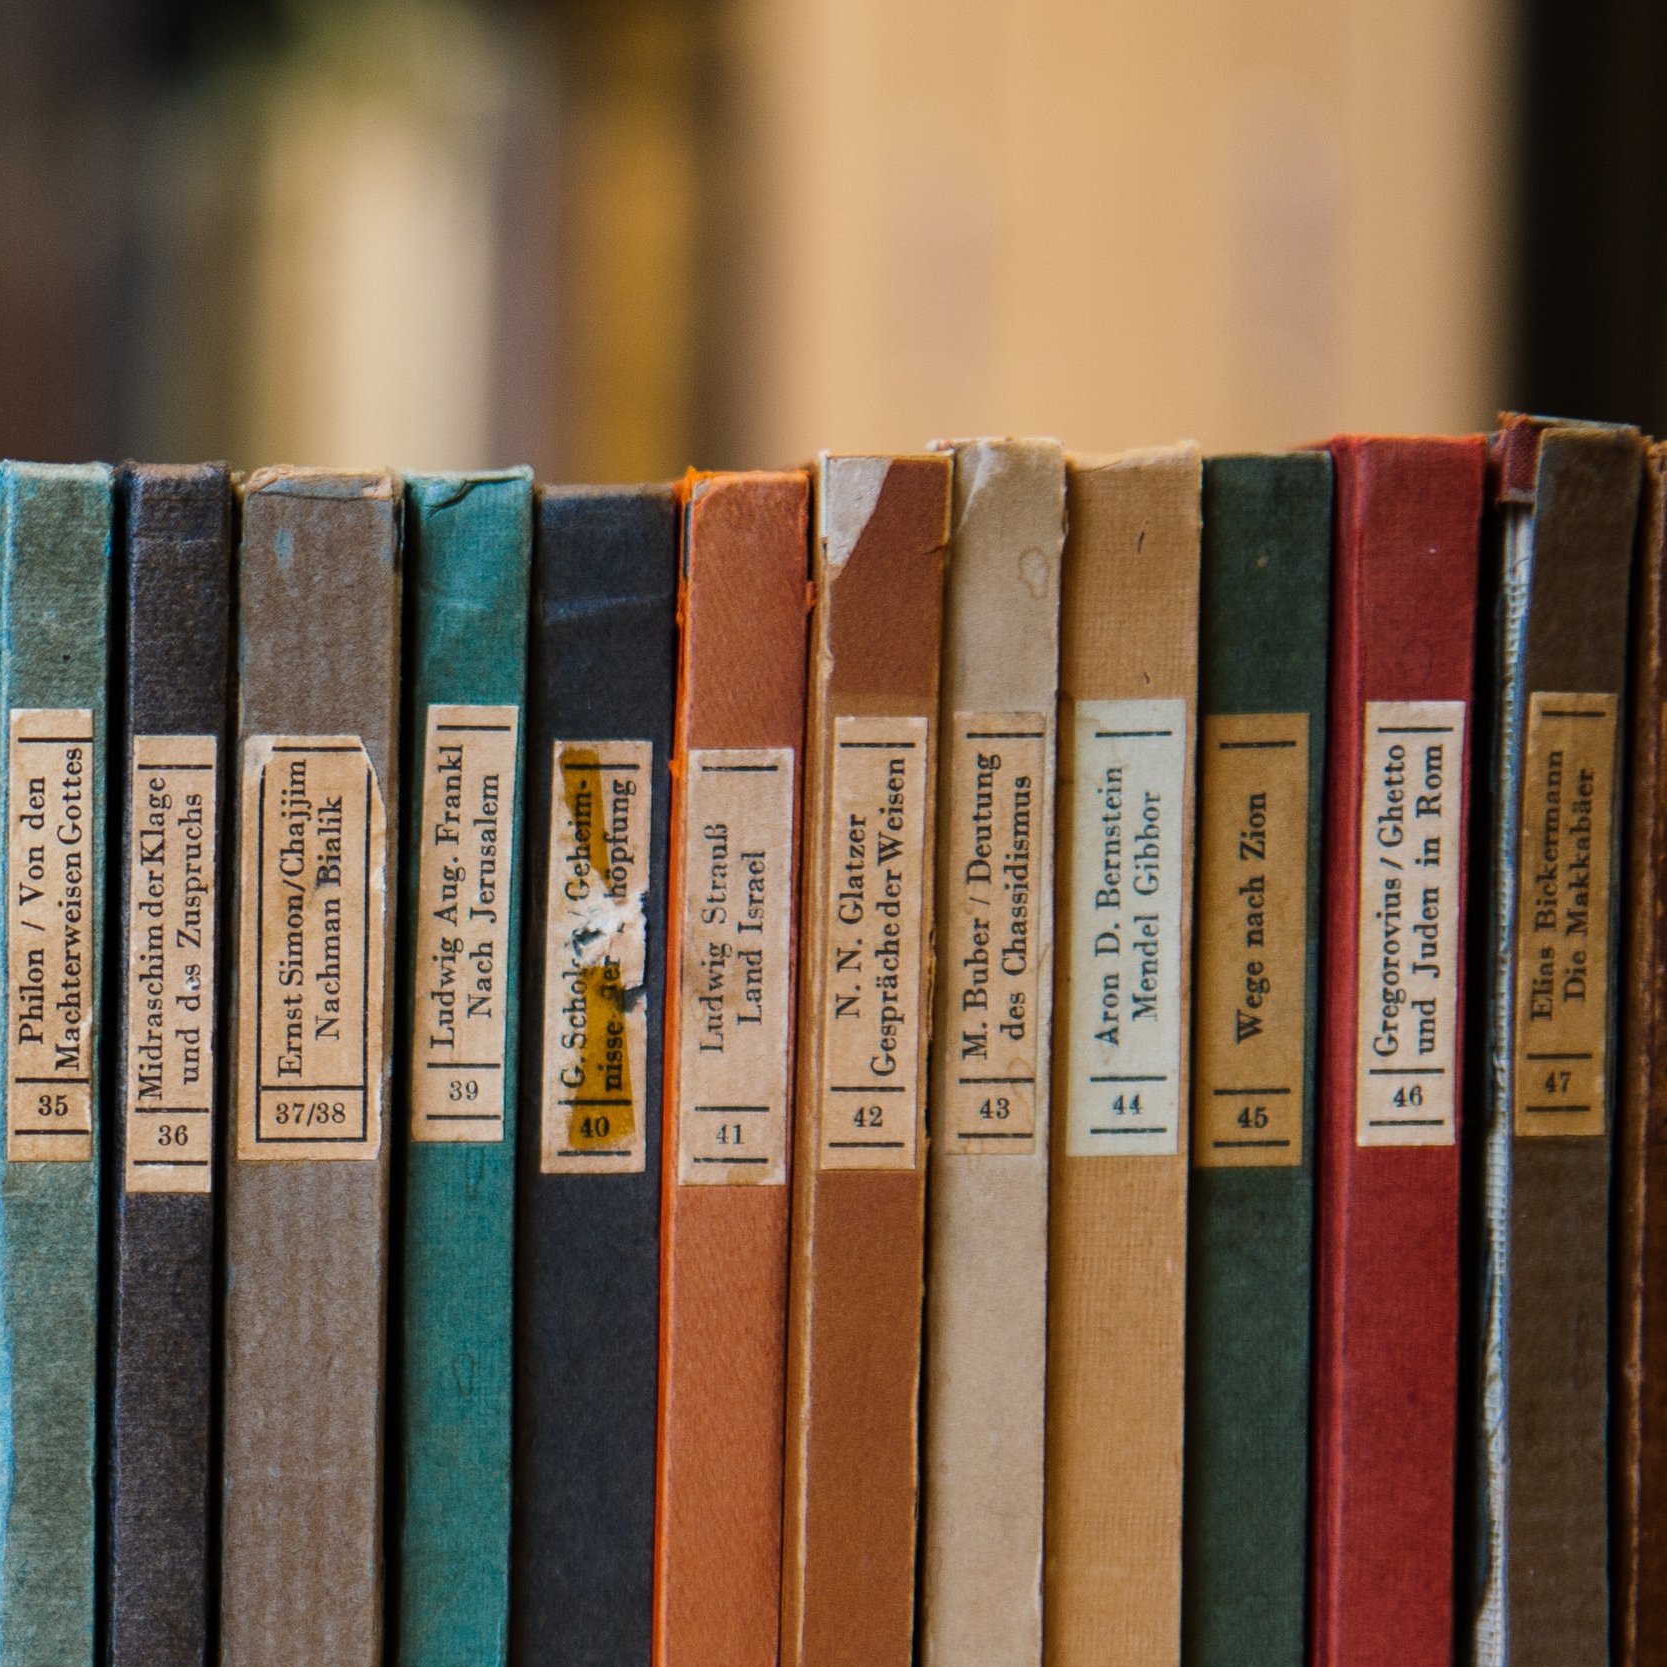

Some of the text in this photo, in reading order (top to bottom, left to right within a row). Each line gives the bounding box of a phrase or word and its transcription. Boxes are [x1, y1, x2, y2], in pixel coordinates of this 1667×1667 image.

[18, 776, 46, 1045] Philon Von den
[54, 747, 83, 1072] Machterweisen Gottes
[137, 777, 173, 1101] Midraschim der Klage
[174, 793, 209, 1086] und Zuspruchs
[313, 795, 343, 1041] Nachman Bialik
[429, 744, 466, 1050] Ludwig Aug. Frankl
[467, 773, 500, 1019] Nach Jerusalem
[698, 823, 733, 1053] Ludwig Strauß
[736, 850, 766, 1026] Land Israel
[835, 813, 867, 1020] N. N. Glatzer
[870, 757, 907, 1078] Gespräche der Weisen
[961, 752, 1002, 1060] M. Buber Deutung
[999, 775, 1032, 1041] des Chassidismus
[1094, 768, 1123, 1046] Aron D. Bernstein
[1131, 791, 1161, 1021] Mendel Gibbor
[1235, 791, 1271, 1045] Wege nach Zion
[1372, 744, 1407, 1058] Gregorovius Ghetto
[1410, 744, 1443, 1056] und Juden in Rom
[37, 1094, 69, 1117] 35
[157, 1124, 189, 1147] 36
[275, 1102, 346, 1127] 37/38
[277, 993, 303, 1078] Ernst
[449, 1080, 479, 1102] 39
[579, 1115, 611, 1139] 40
[714, 1122, 743, 1146] 41
[853, 1105, 883, 1128] 42
[979, 1097, 1010, 1120] 43
[1112, 1094, 1141, 1115] 44
[1237, 1106, 1269, 1129] 45
[1393, 1084, 1424, 1108] 46
